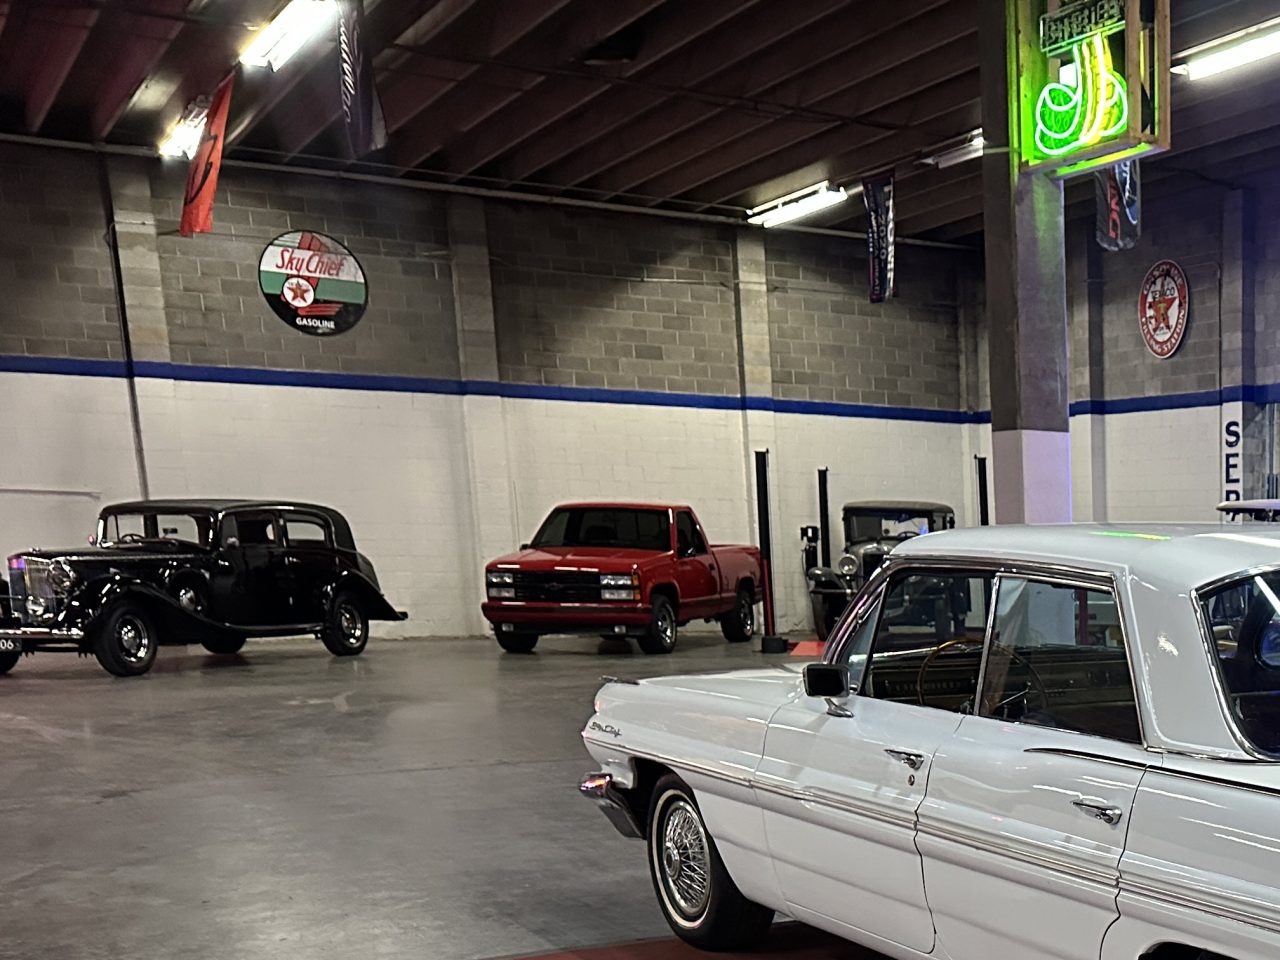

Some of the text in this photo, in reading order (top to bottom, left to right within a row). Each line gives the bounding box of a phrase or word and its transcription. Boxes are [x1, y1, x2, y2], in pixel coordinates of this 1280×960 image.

[276, 248, 347, 276] Sky Chief
[296, 317, 335, 329] GASOLINE
